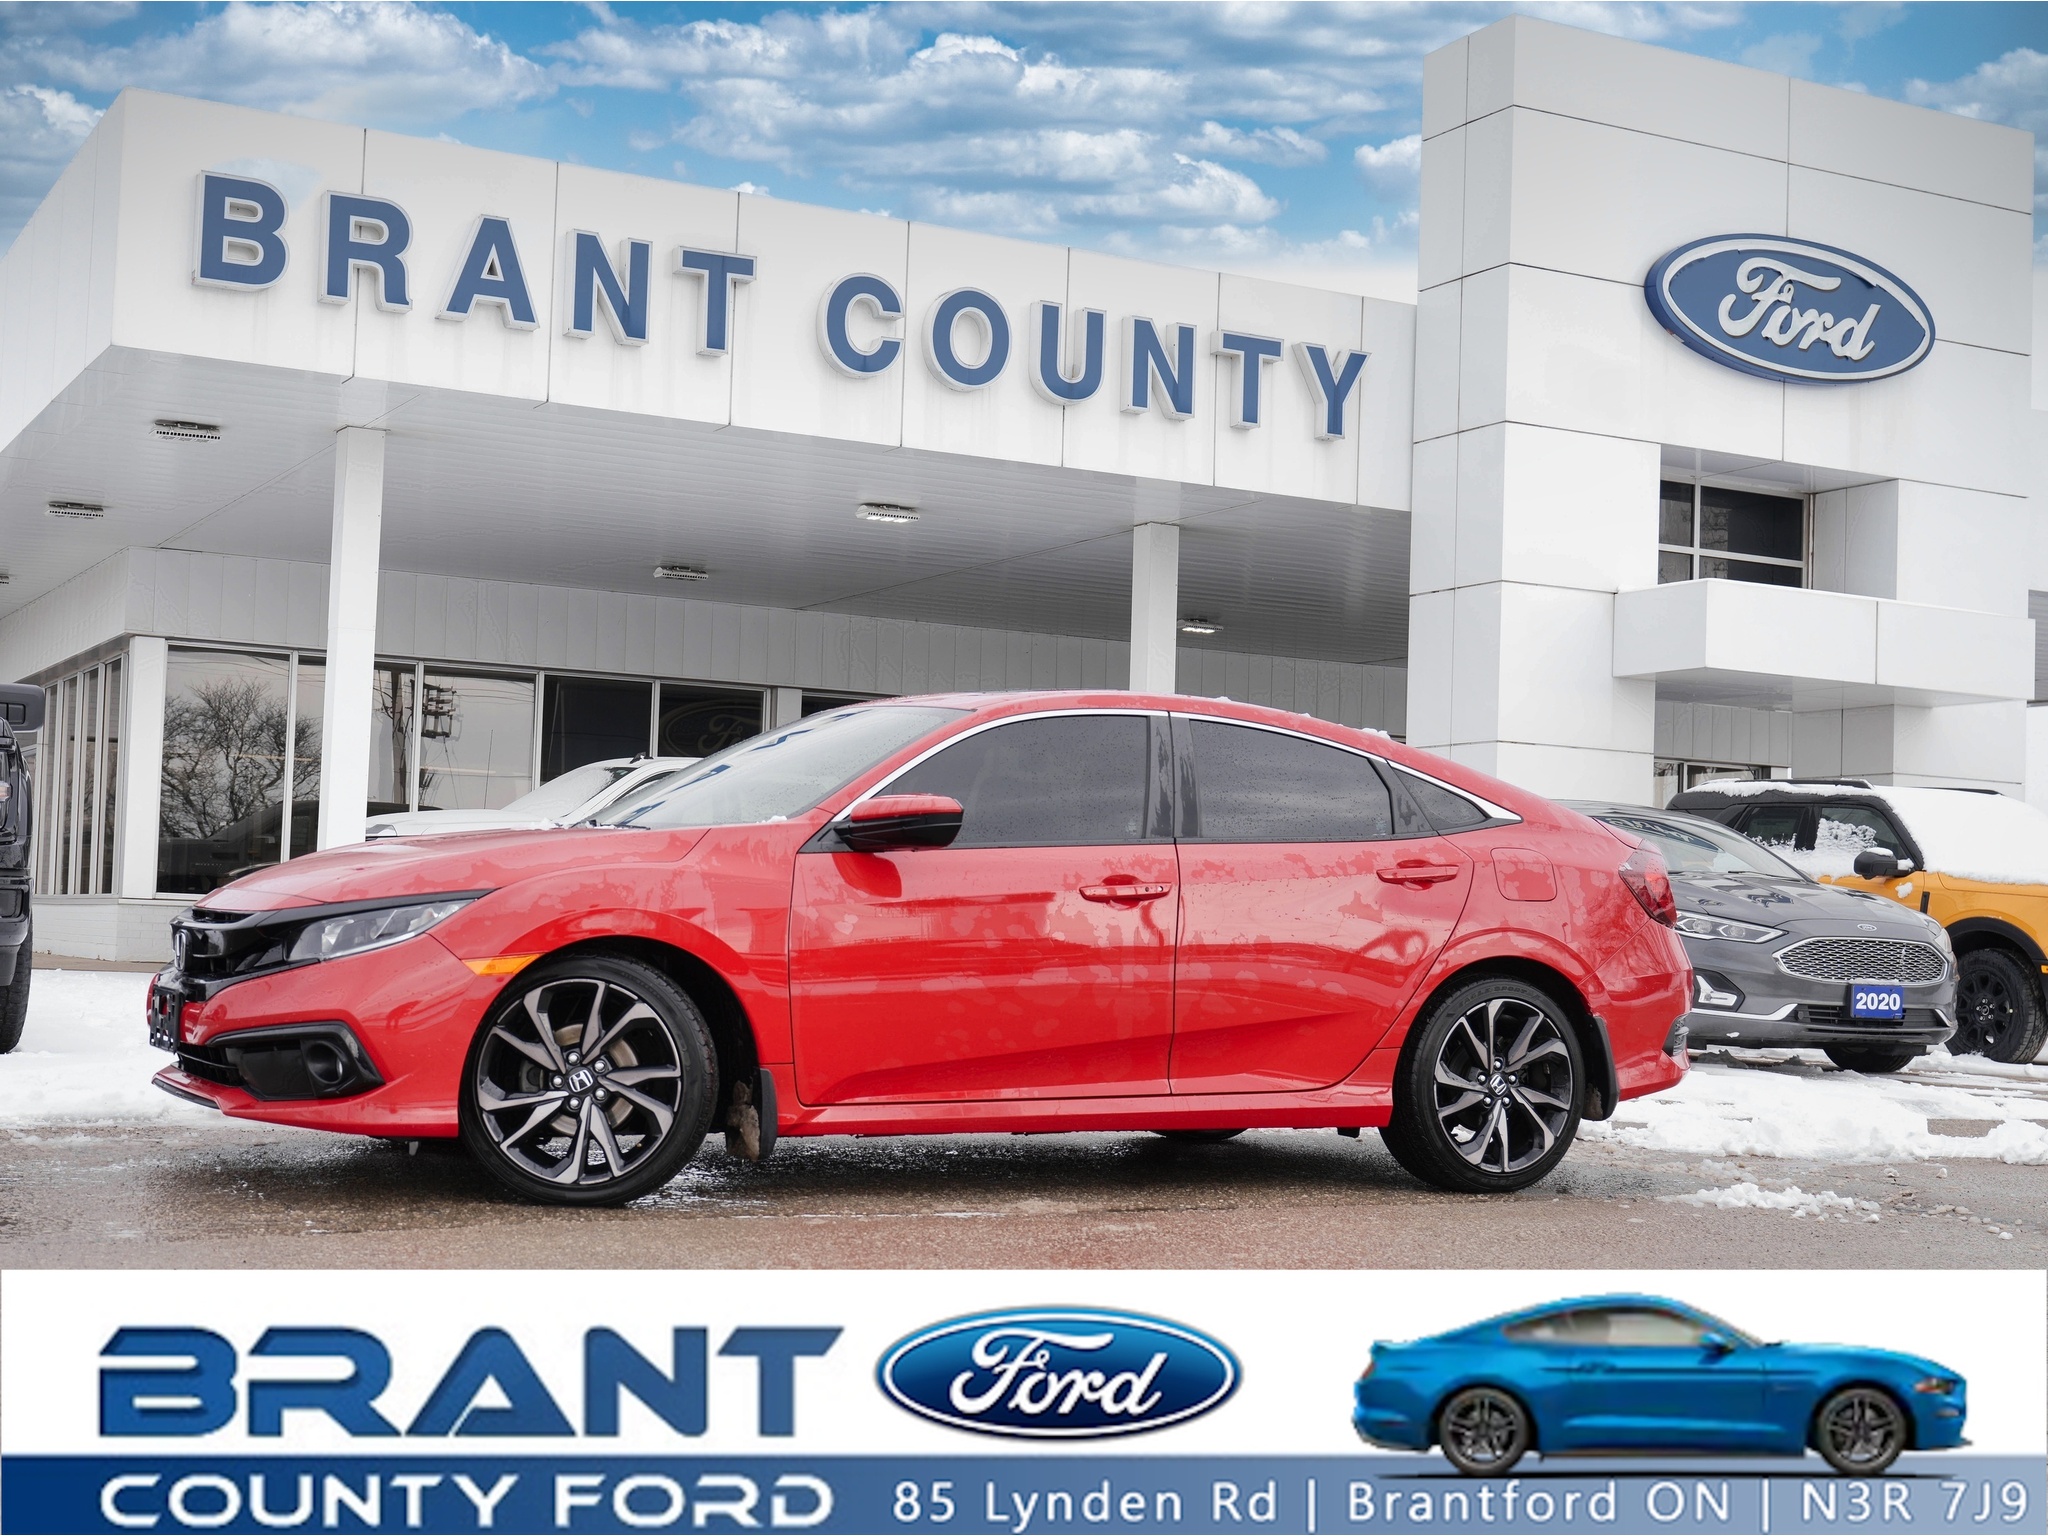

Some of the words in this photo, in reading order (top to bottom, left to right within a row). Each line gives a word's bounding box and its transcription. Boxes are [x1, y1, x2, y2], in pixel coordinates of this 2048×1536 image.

[192, 171, 757, 356] BRANT
[816, 272, 1372, 441] COUNTY
[1718, 256, 1882, 361] Ford
[1493, 986, 1527, 994] SPORT
[1855, 992, 1901, 1011] 2020
